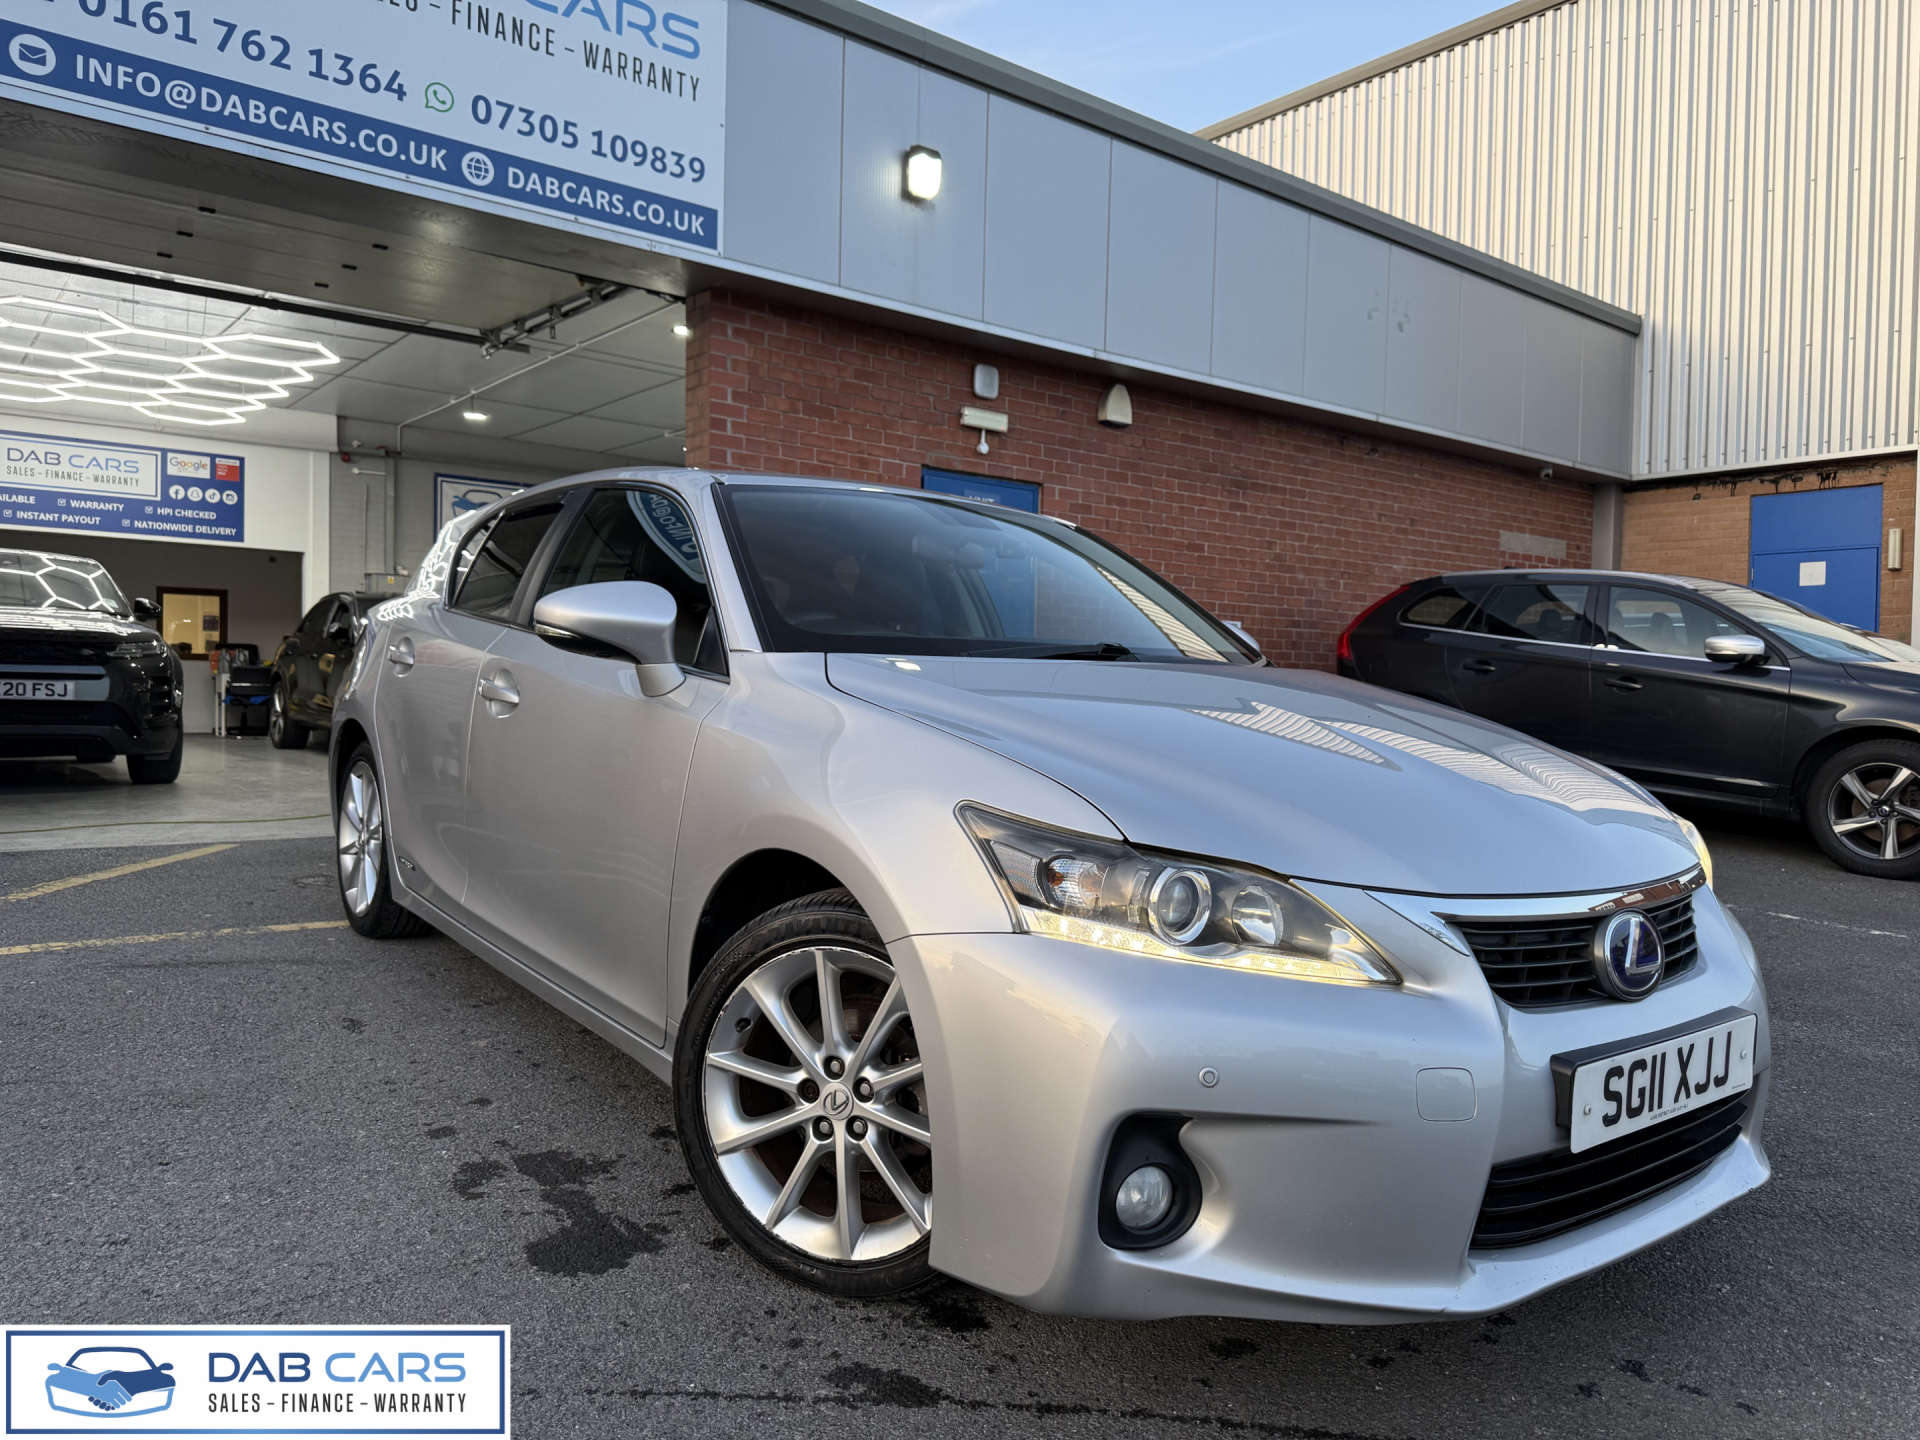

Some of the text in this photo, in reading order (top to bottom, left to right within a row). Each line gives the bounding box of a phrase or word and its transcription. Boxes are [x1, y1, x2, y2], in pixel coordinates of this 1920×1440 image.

[525, 0, 700, 59] ARS
[213, 18, 291, 70] 762
[308, 48, 407, 102] 1364
[452, 0, 555, 56] FINANCE
[583, 40, 700, 101] WARRANTY
[75, 53, 448, 171] INFO@DABCARS.CO.UK
[471, 94, 705, 183] 07305 109839
[507, 166, 704, 236] DABCARS.CO.UK
[7, 447, 140, 474] DAB CARS
[169, 456, 208, 472] Google
[6, 465, 35, 477] SALES
[45, 469, 83, 482] FINANCE
[93, 474, 140, 487] WARRANTY
[16, 510, 101, 525] INSTANT PAYOUT
[70, 499, 124, 512] WARRANTY
[157, 507, 217, 520] HPI CHECKED
[134, 519, 236, 536] NATIONWIDE DELIVERY
[0, 682, 68, 697] 20 FSJ
[1674, 1031, 1733, 1104] XJJ
